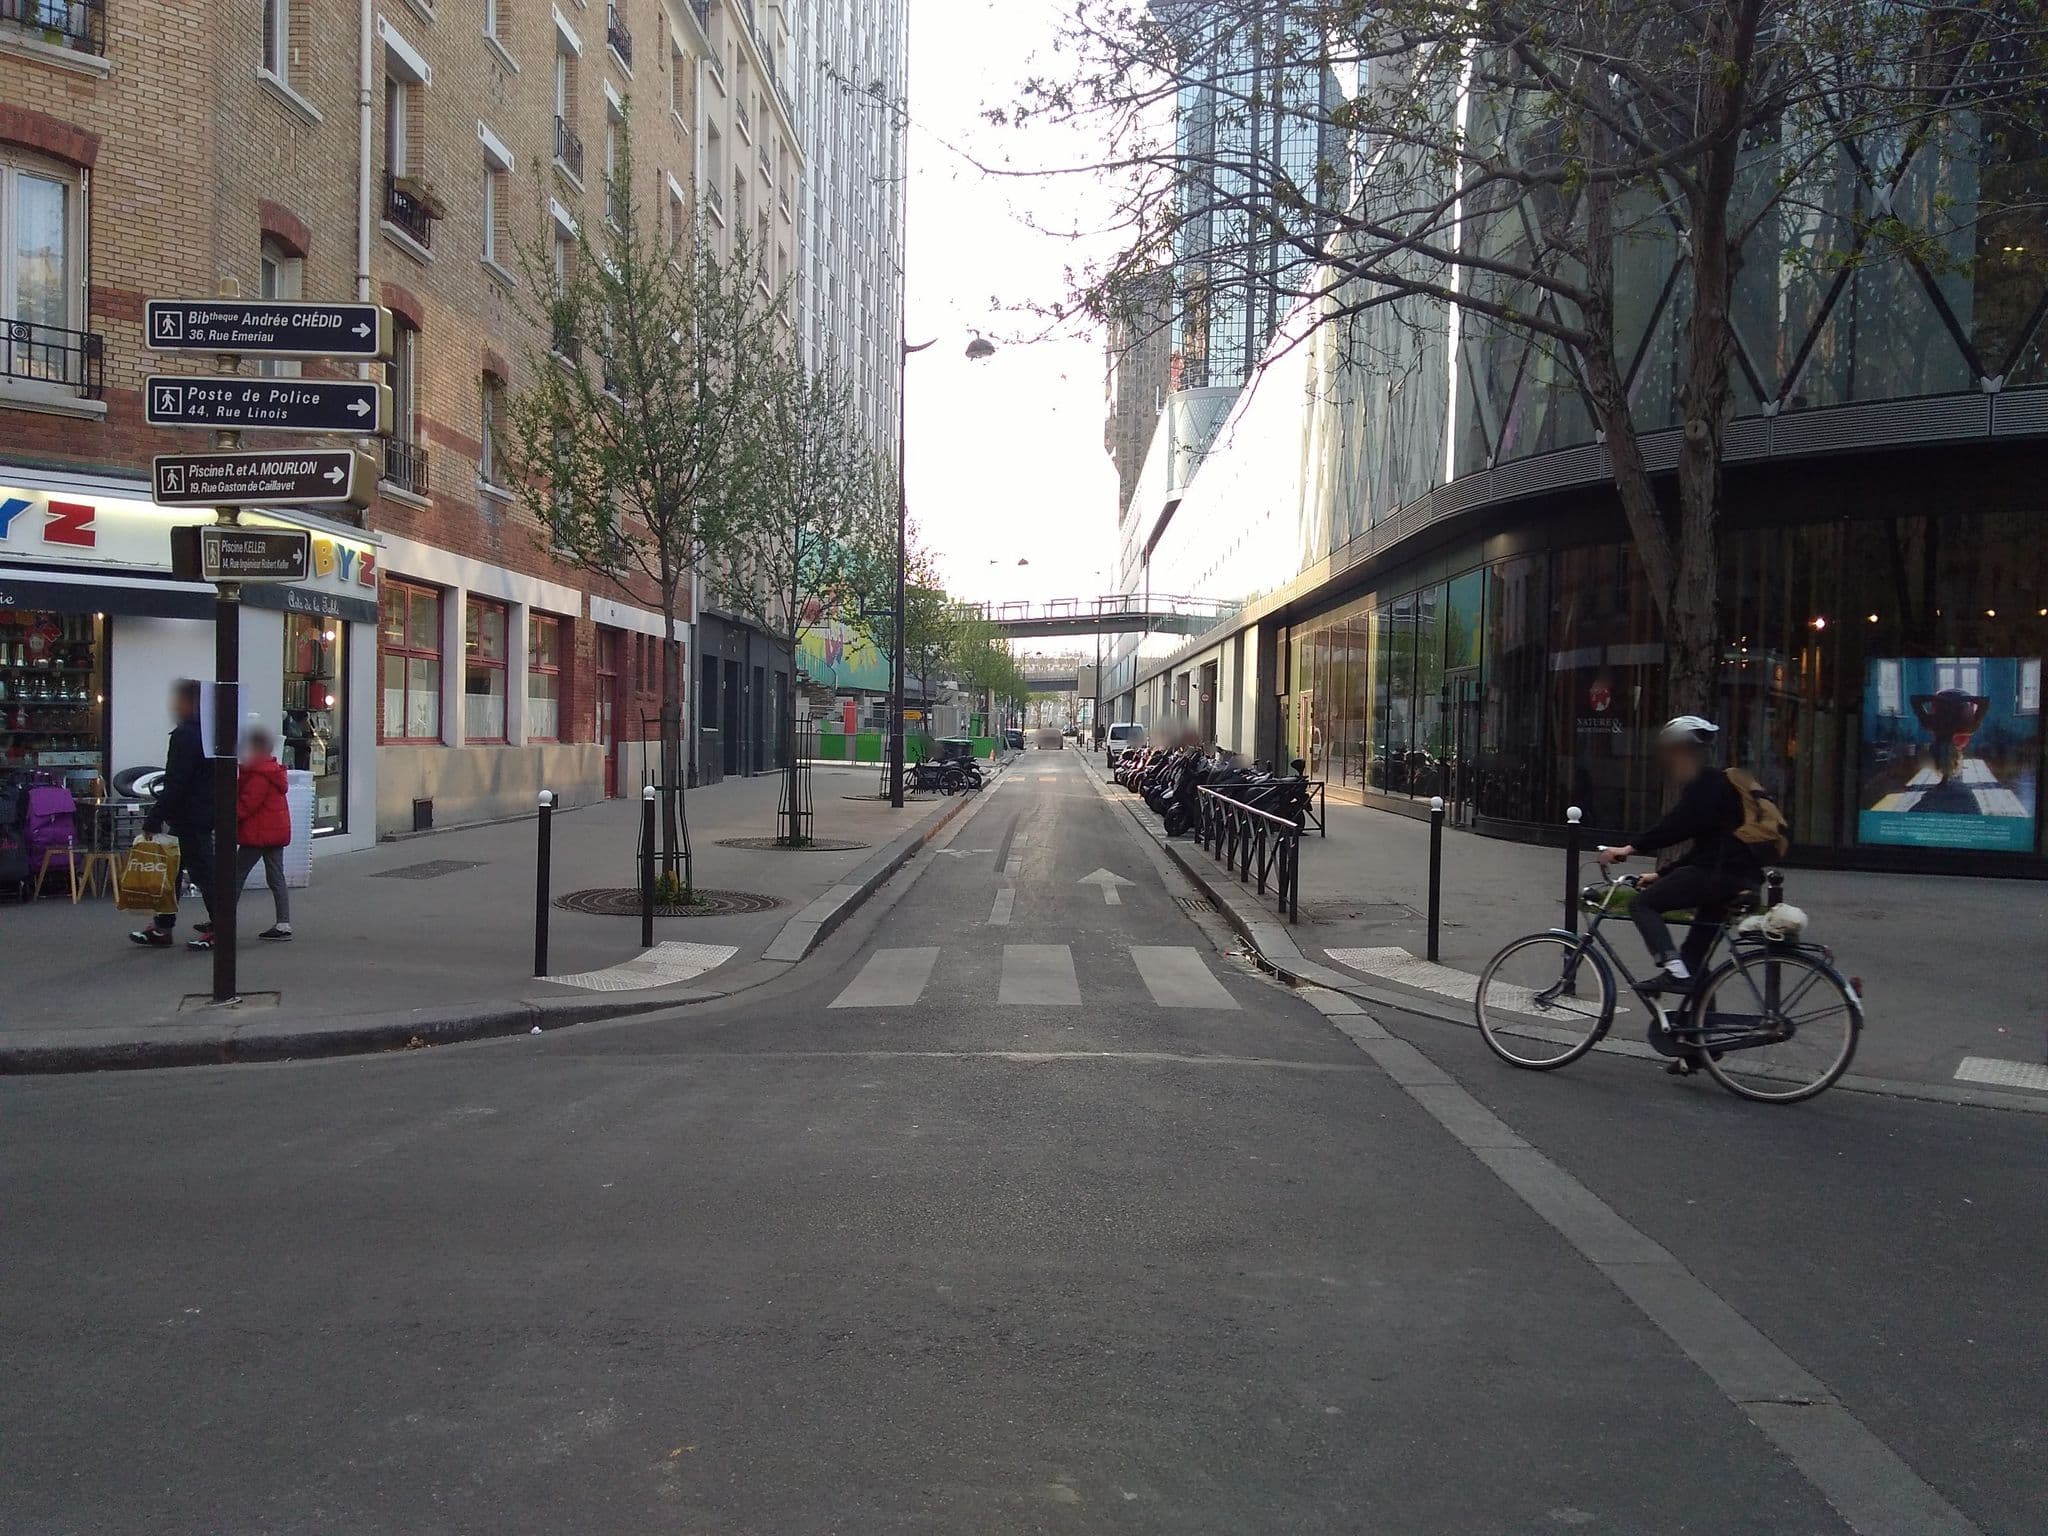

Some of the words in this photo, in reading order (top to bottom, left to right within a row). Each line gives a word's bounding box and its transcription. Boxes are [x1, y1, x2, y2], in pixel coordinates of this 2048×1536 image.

[241, 312, 289, 327] Andrée
[291, 311, 343, 328] CHÉDID
[188, 329, 206, 341] 36,
[208, 329, 230, 341] Rue
[231, 330, 274, 342] Emeriau
[187, 386, 233, 401] Poste
[242, 388, 260, 402] de
[269, 389, 320, 405] Police
[187, 404, 209, 418] 44,
[216, 405, 241, 417] Rue
[247, 407, 288, 419] Linois
[188, 464, 225, 478] Piscine
[225, 463, 235, 477] R.
[235, 464, 248, 476] et
[248, 462, 259, 476] A.
[259, 461, 318, 475] MOURLON
[190, 482, 200, 495] 19,
[200, 482, 217, 493] Rue
[217, 481, 247, 493] Gaston
[247, 481, 258, 491] de
[258, 479, 296, 491] Caillavet
[221, 539, 244, 553] Piscine
[243, 541, 266, 553] KELLER
[229, 558, 240, 569] Rue
[313, 539, 377, 588] BYZ
[128, 858, 167, 872] fnac
